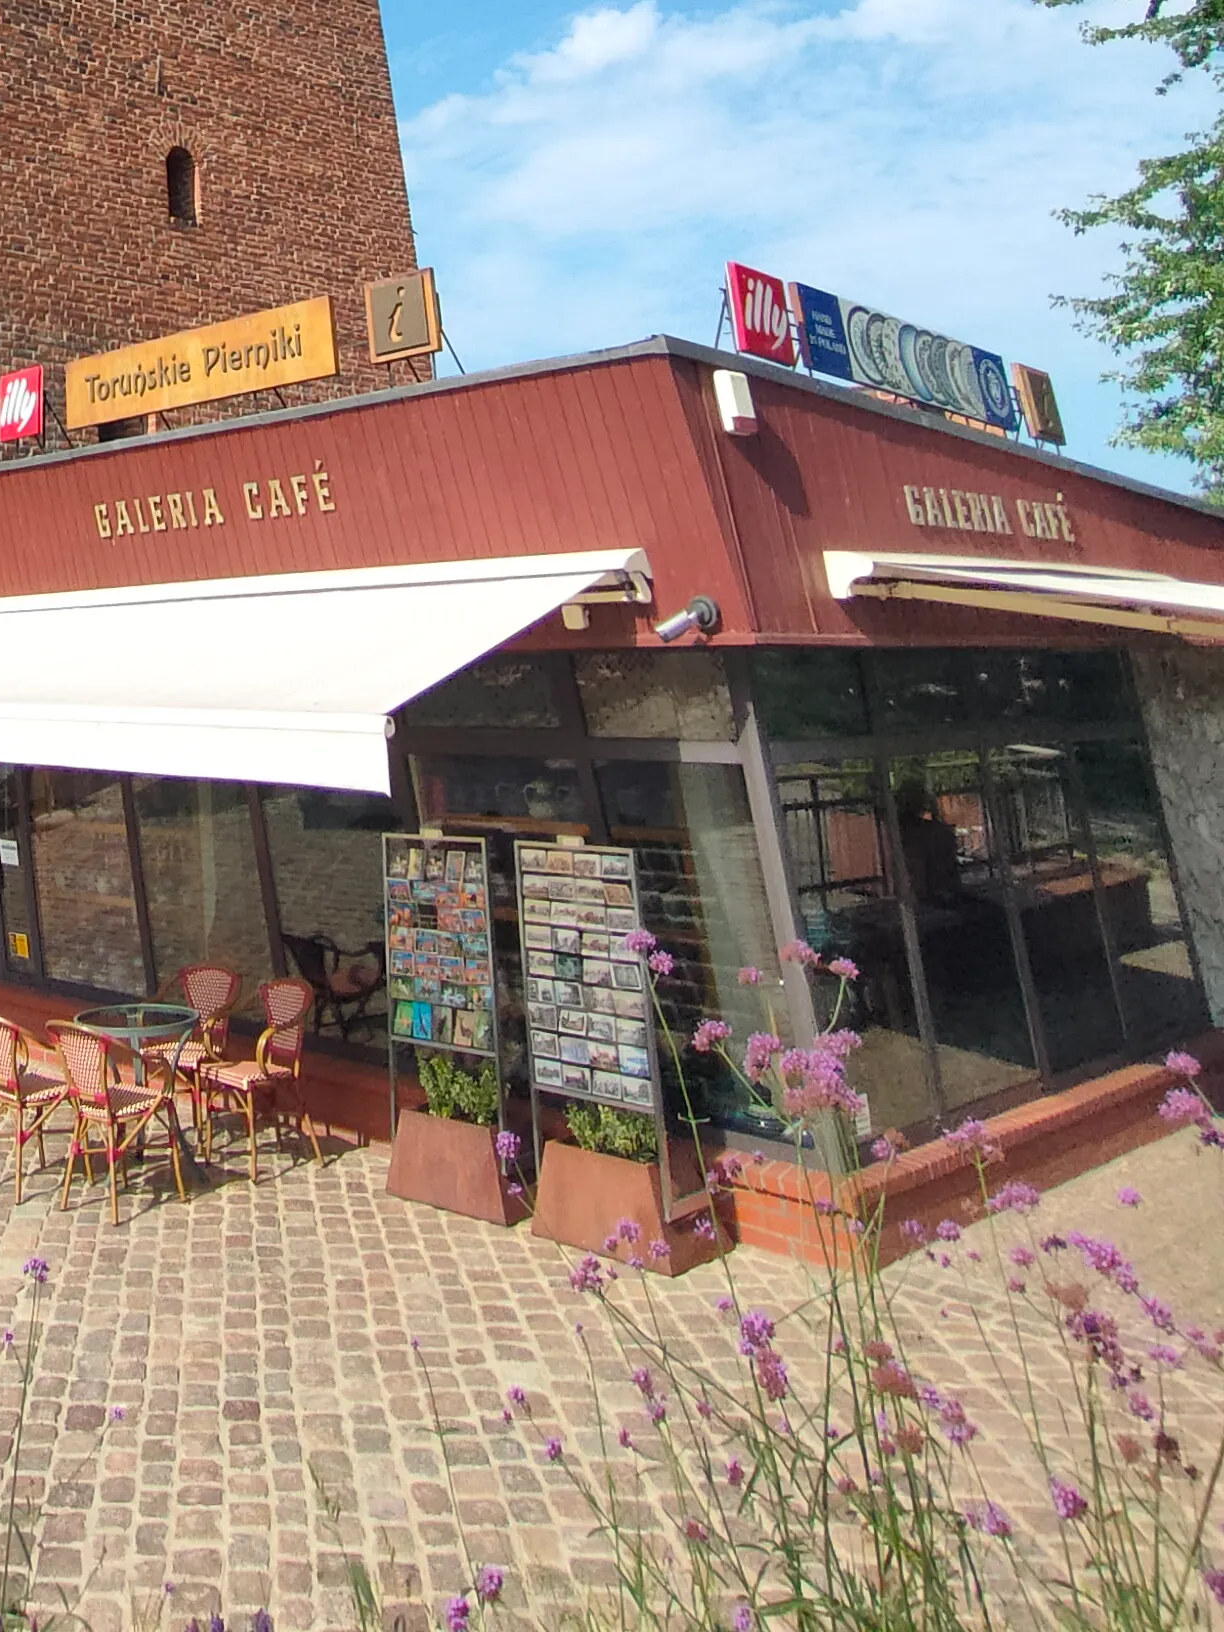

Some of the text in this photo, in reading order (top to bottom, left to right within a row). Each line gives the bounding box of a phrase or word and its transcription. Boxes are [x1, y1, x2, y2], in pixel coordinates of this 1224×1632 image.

[387, 285, 406, 343] i
[745, 277, 786, 350] illy
[84, 324, 303, 404] Toruńskie Pierniki
[93, 460, 336, 538] GALERIA CAFÉ
[904, 485, 1076, 542] GALERIA CAFÉ
